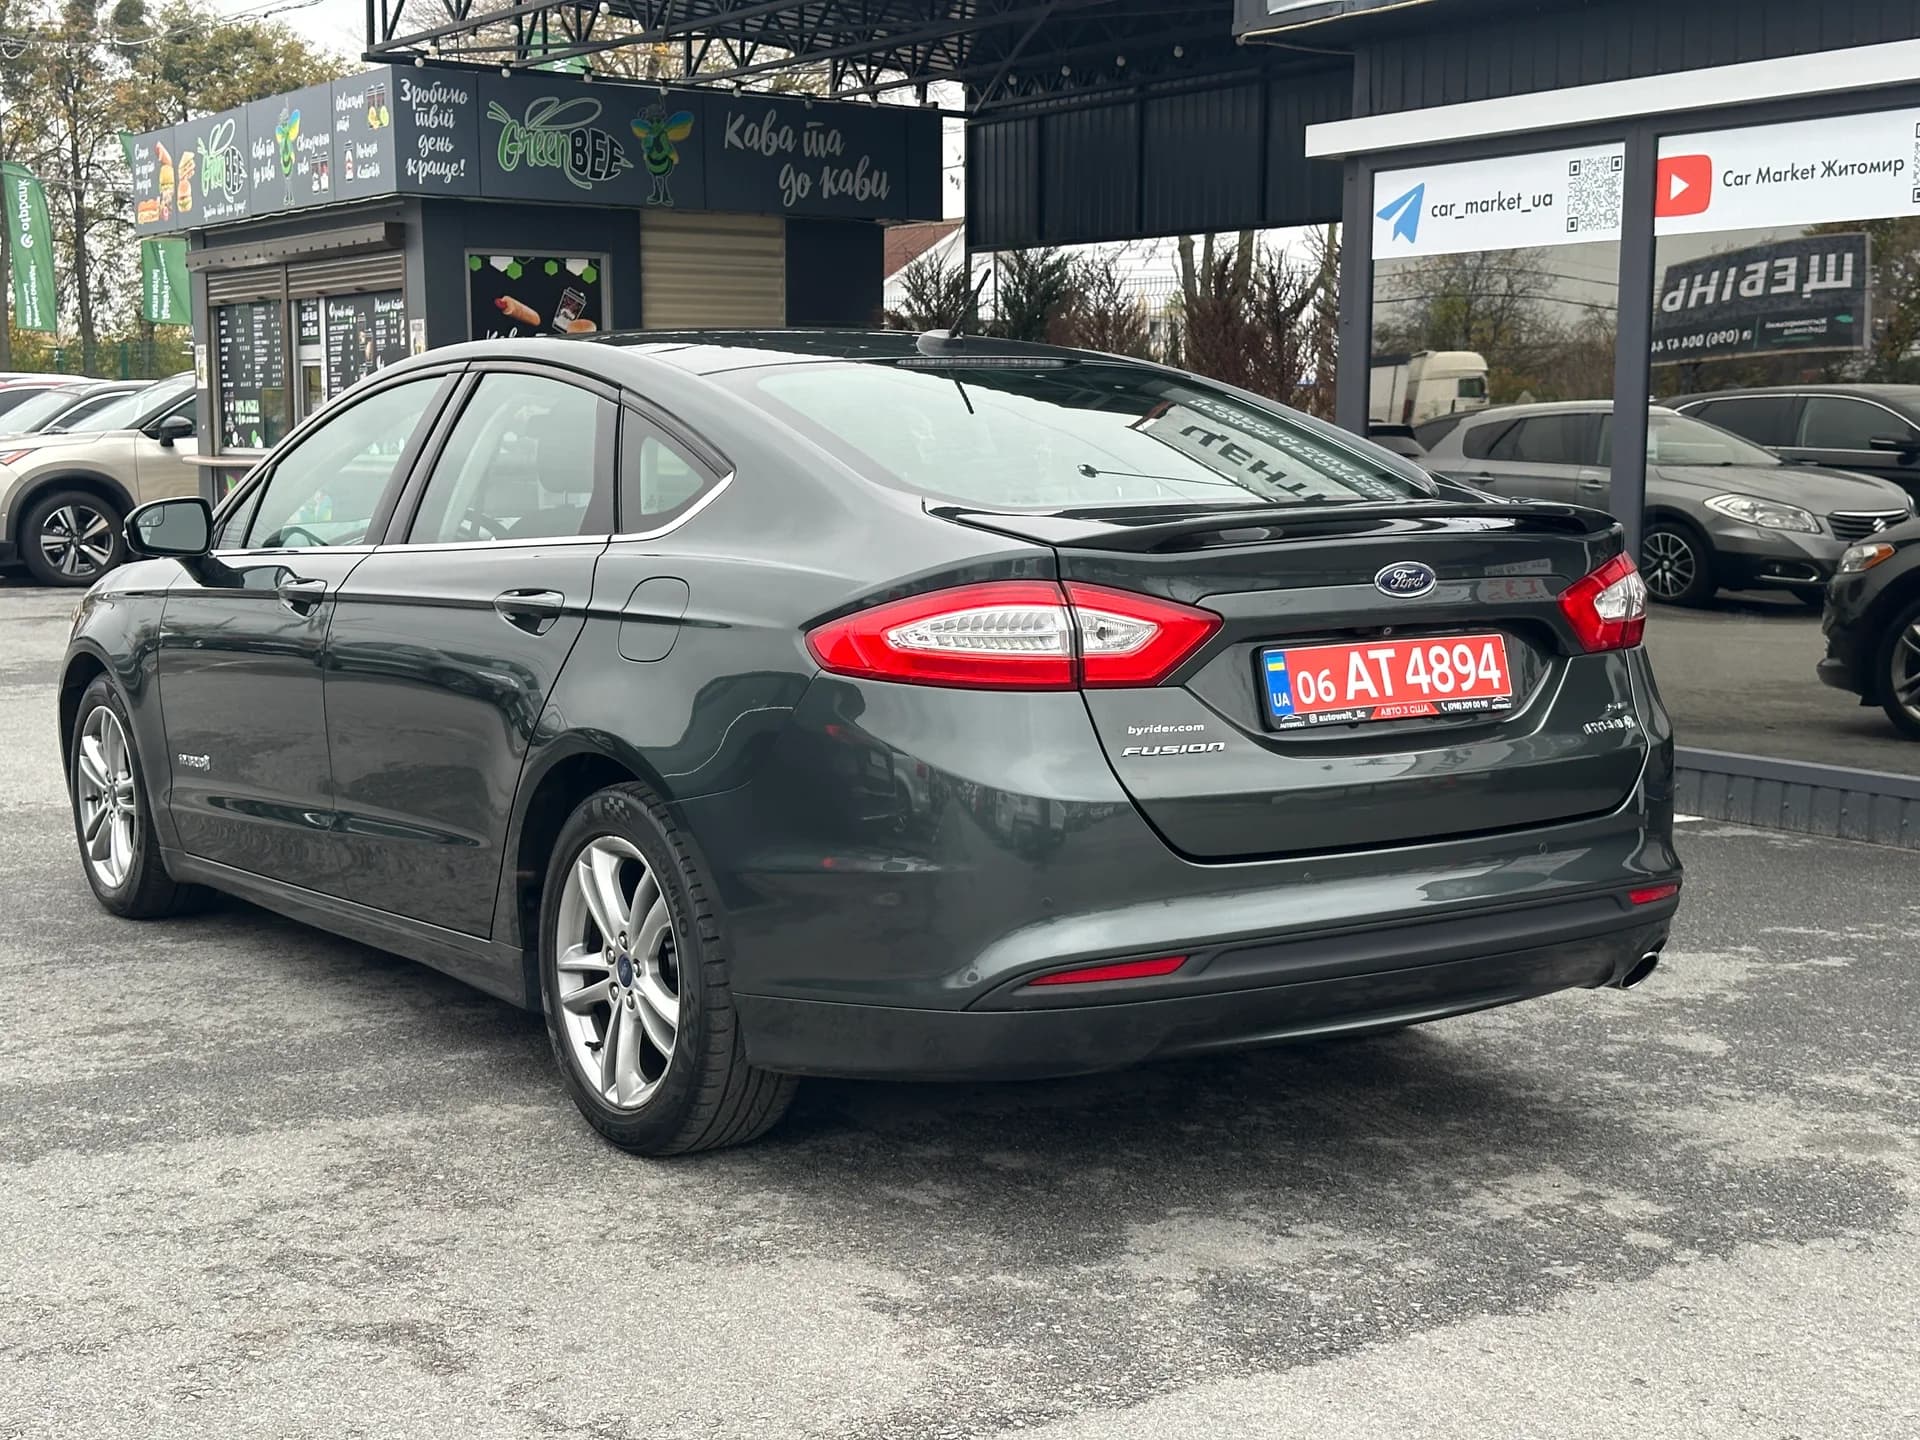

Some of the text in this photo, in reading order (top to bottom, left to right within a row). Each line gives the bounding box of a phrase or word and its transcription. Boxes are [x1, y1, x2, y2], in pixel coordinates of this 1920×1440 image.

[400, 79, 468, 109] Зробимо
[415, 105, 455, 128] твій
[418, 134, 454, 158] день
[724, 109, 845, 158] Кава та
[498, 119, 627, 189] GreenBEE
[406, 158, 465, 184] краще!
[779, 155, 890, 207] до кави
[1723, 158, 1905, 187] Car Market Житомир
[1431, 191, 1553, 219] car_market_ua
[1390, 569, 1425, 589] Ford
[1297, 642, 1501, 704] 06 AT 4894
[1273, 692, 1291, 707] UA
[1381, 707, 1401, 716] АВТО
[1410, 704, 1429, 714] США
[1127, 723, 1205, 736] byrider.com
[1121, 741, 1225, 757] FUSION
